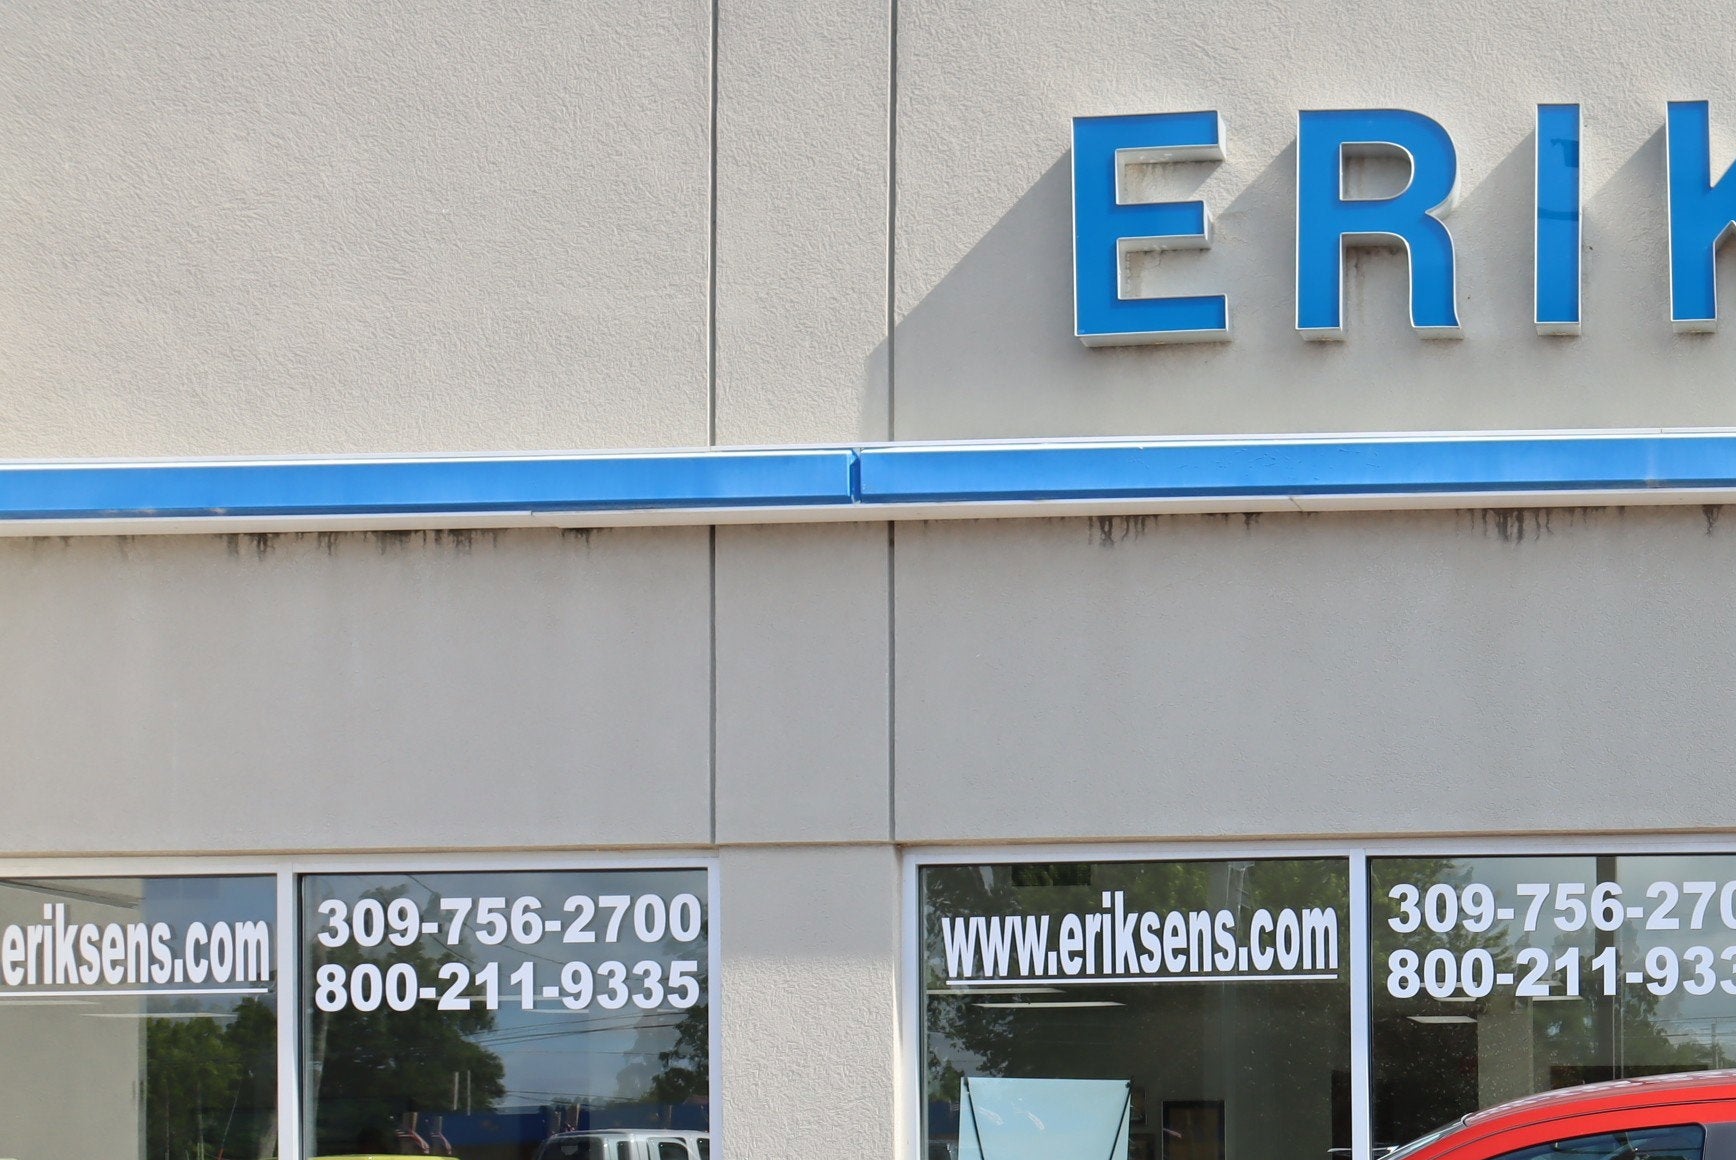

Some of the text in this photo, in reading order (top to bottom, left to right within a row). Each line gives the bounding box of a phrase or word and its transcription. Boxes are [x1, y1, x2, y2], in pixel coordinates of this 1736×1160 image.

[1, 902, 270, 986] eriksens.com
[317, 893, 701, 948] 309-756-2700
[941, 890, 1338, 977] www.eriksens.com
[315, 959, 700, 1012] 800-211-9335
